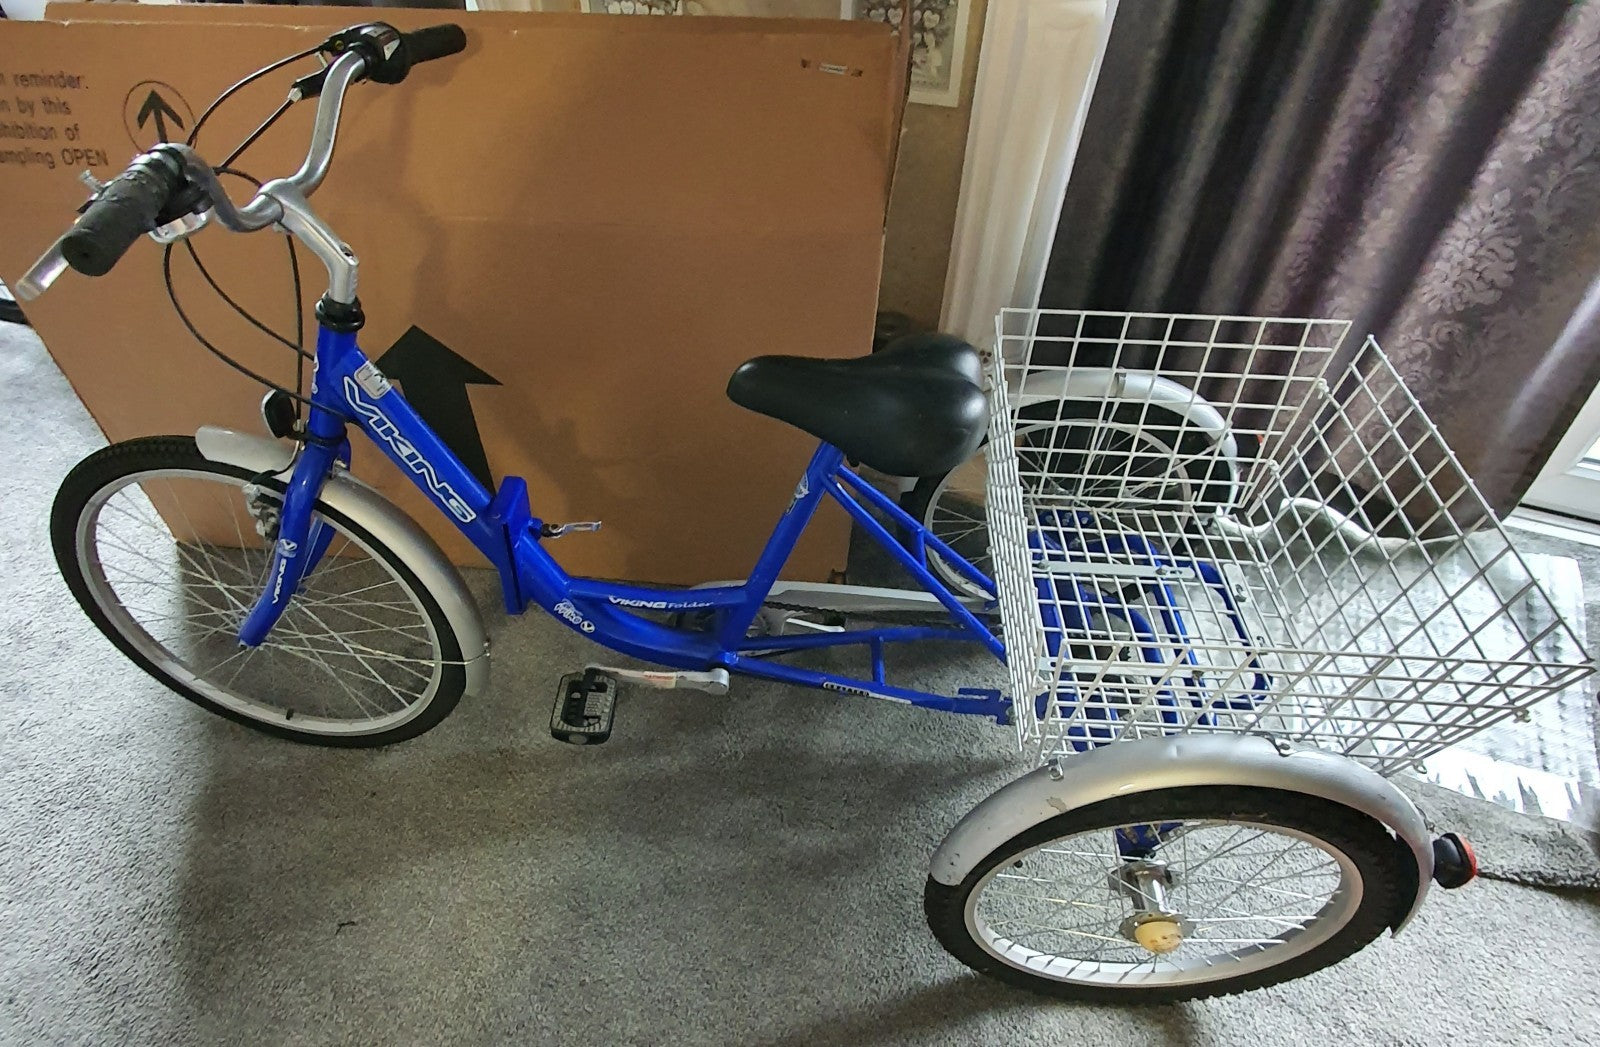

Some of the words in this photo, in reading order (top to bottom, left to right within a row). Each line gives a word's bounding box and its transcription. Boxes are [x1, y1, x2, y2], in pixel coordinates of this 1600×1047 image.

[16, 96, 35, 118] by
[41, 96, 72, 115] this
[64, 122, 80, 141] of
[61, 147, 109, 167] OPEN
[343, 376, 477, 523] VIKING
[608, 594, 668, 609] VIKING
[667, 601, 714, 610] Folder
